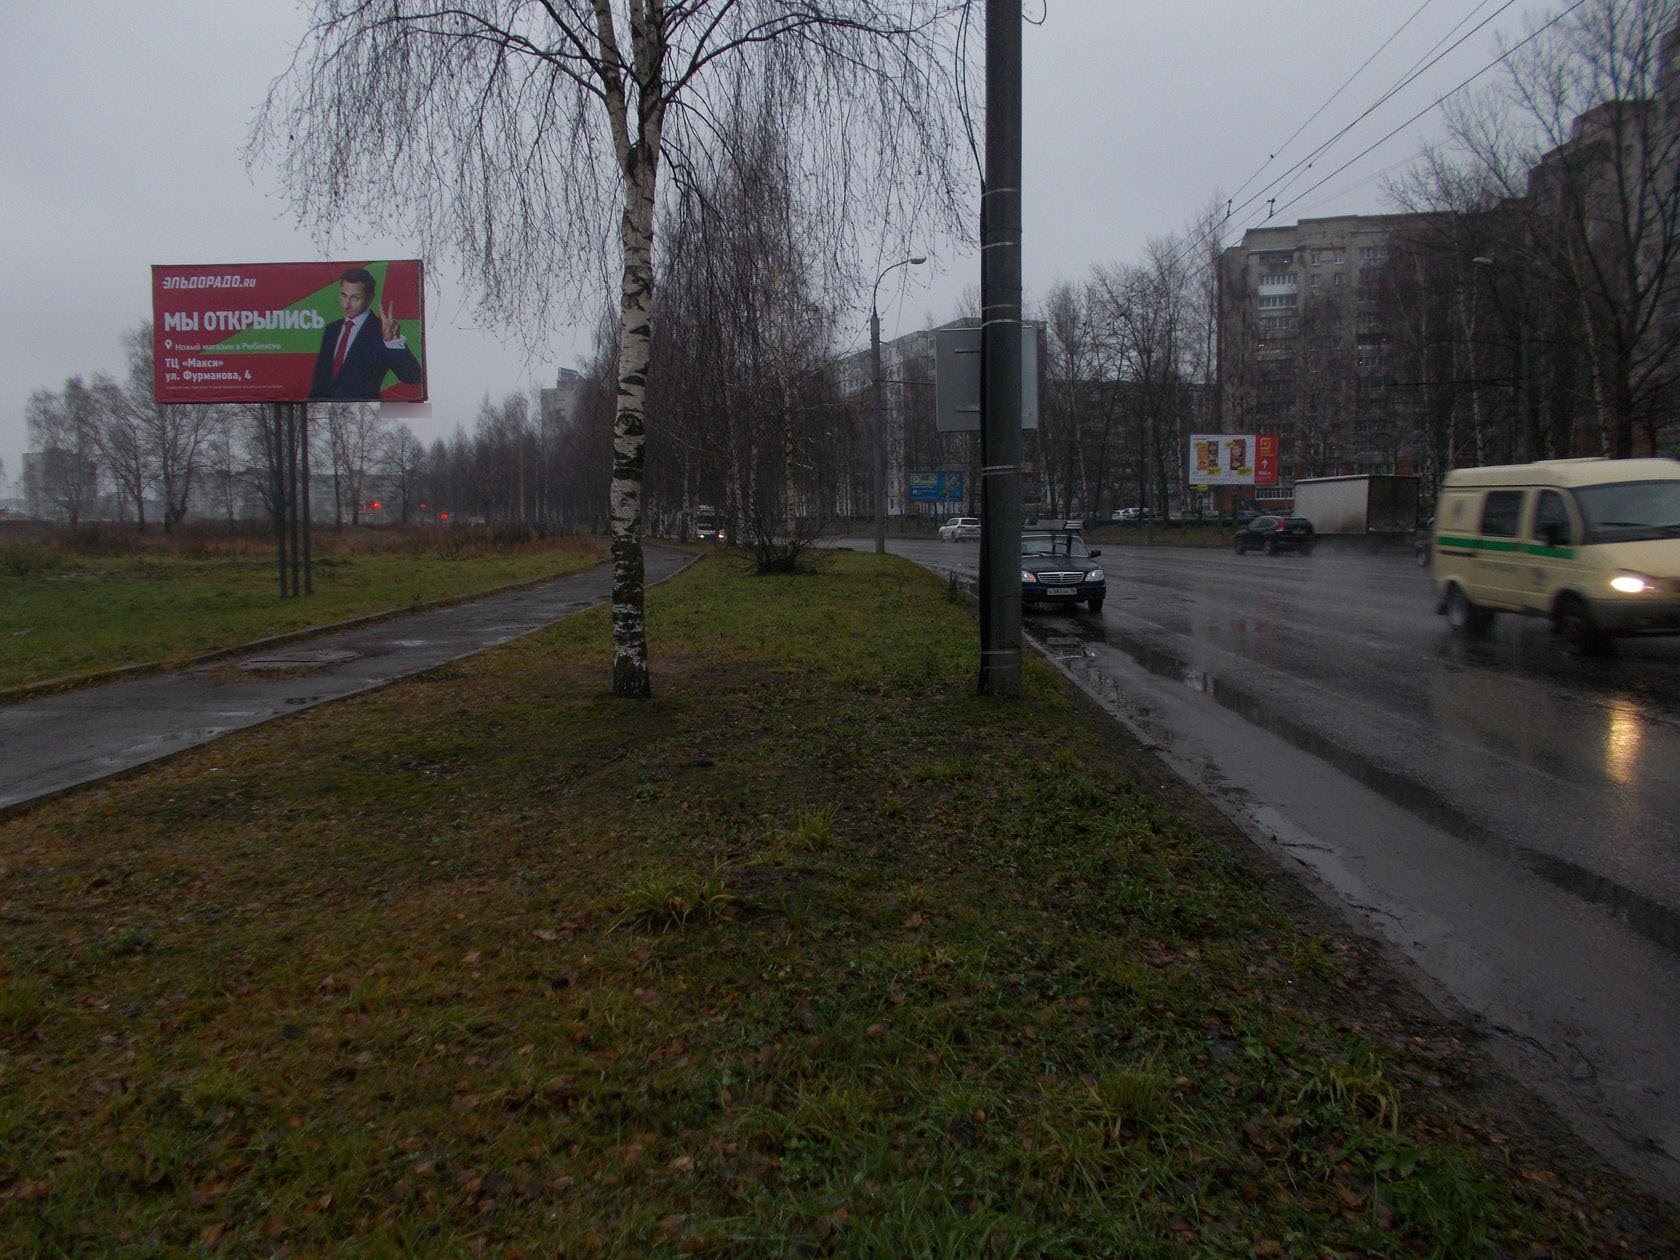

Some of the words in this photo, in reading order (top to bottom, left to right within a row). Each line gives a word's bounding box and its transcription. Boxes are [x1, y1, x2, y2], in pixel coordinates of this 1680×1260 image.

[164, 312, 199, 331] МЫ
[204, 309, 325, 331] ОТКРЫЛИСЬ
[175, 343, 201, 351] Новый
[165, 358, 179, 369] ТЦ
[182, 358, 224, 368] «Макси»
[165, 373, 180, 383] ул.
[183, 370, 241, 382] Фурманова,
[244, 370, 252, 380] 4
